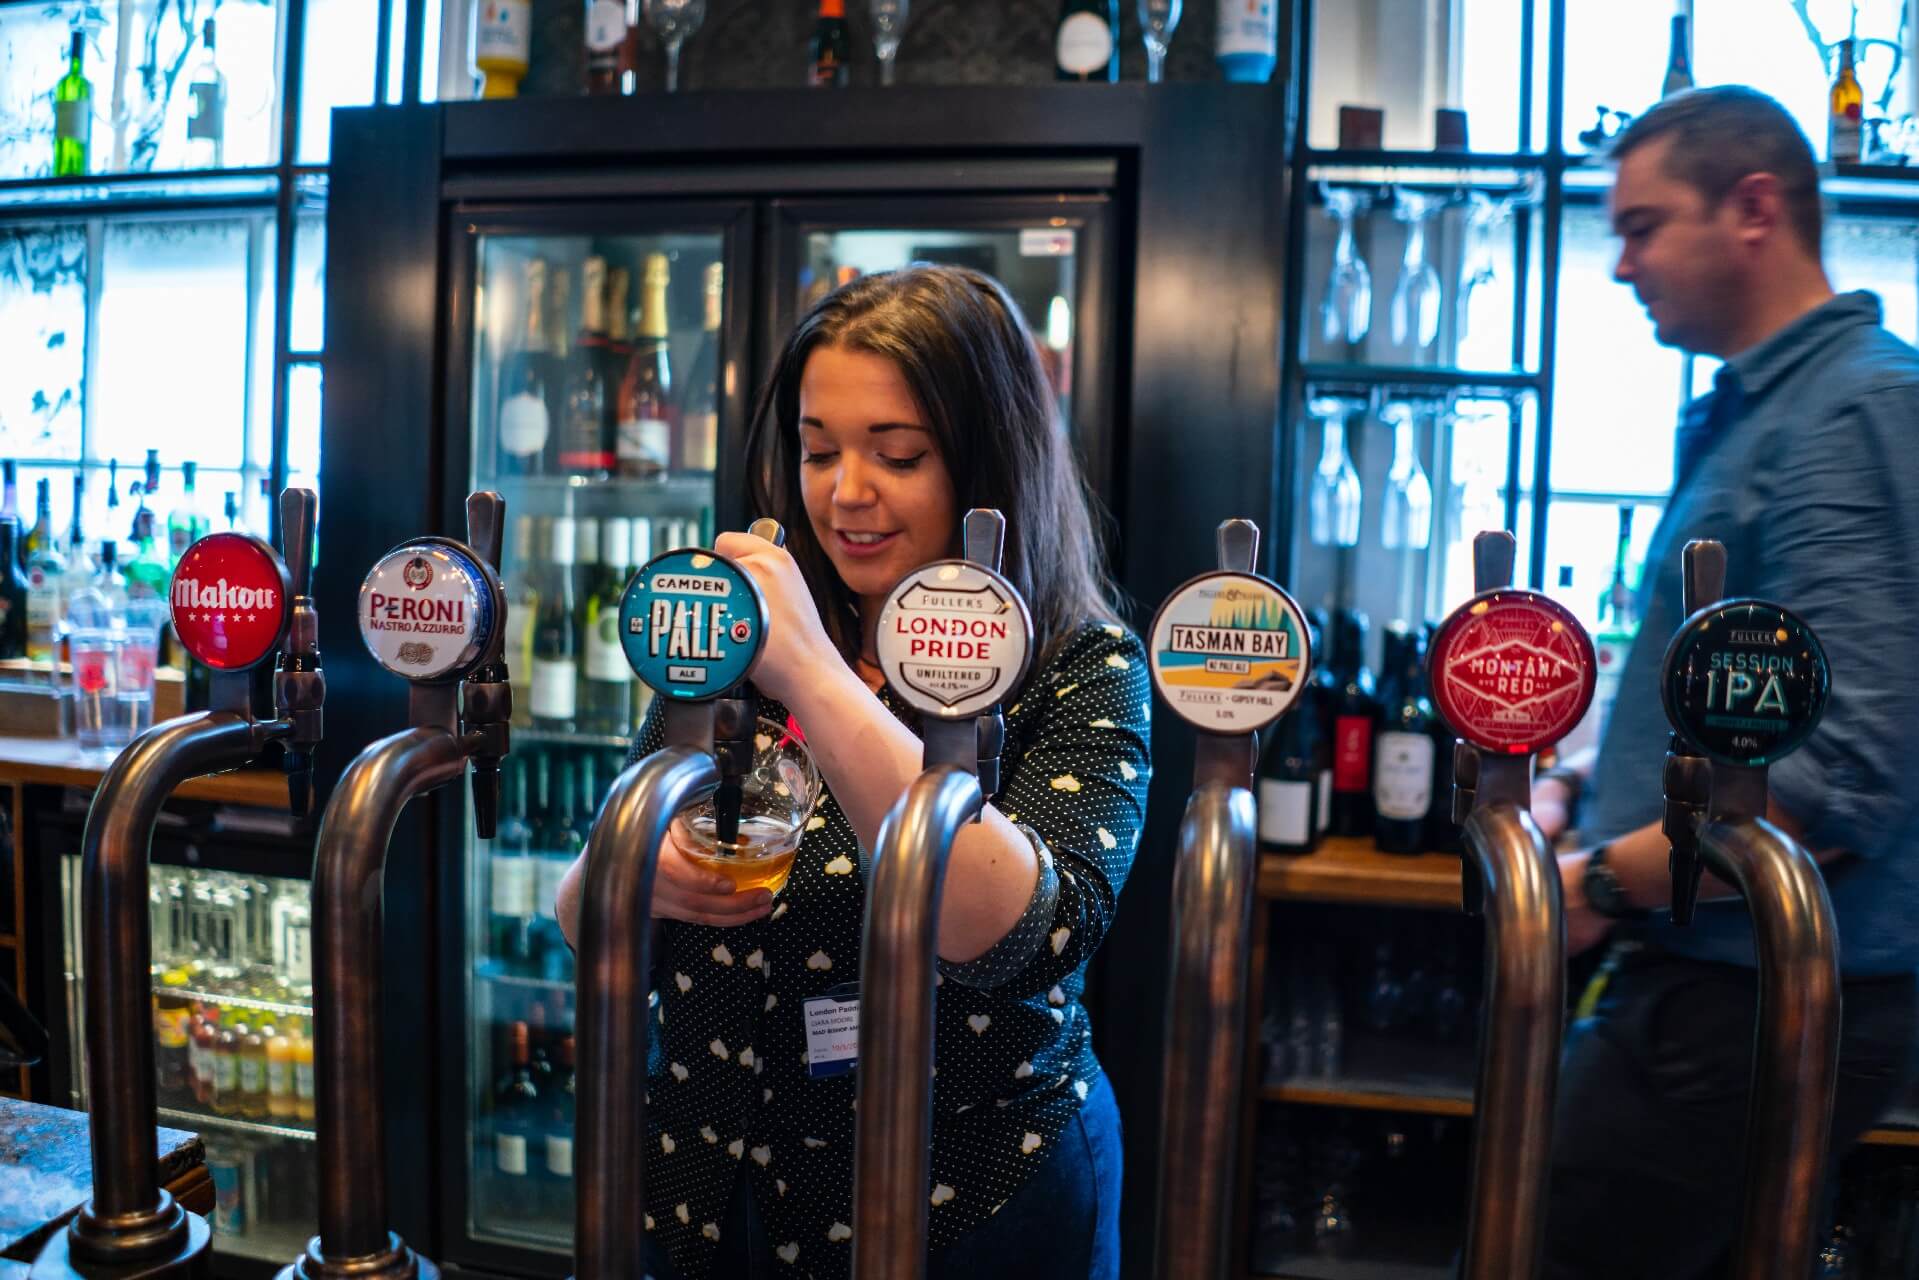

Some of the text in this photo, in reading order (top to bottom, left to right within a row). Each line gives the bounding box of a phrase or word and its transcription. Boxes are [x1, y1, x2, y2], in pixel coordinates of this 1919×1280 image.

[657, 578, 724, 593] CAMDEN
[370, 593, 464, 622] PERONI
[370, 619, 465, 635] NASTRO AZZURRO
[650, 599, 728, 659] PALE
[897, 616, 1007, 639] LONDON
[911, 639, 991, 660] PRIDE
[1175, 629, 1285, 655] TASMAN BAY
[1219, 661, 1232, 670] PALE
[1235, 663, 1246, 672] ALE
[1471, 658, 1562, 678] MONTANA
[1710, 652, 1794, 672] SESSION
[679, 669, 696, 678] ALE
[916, 668, 981, 681] UNFILTERED
[1497, 678, 1534, 695] RED
[1706, 670, 1789, 715] IPA
[810, 1008, 836, 1016] London
